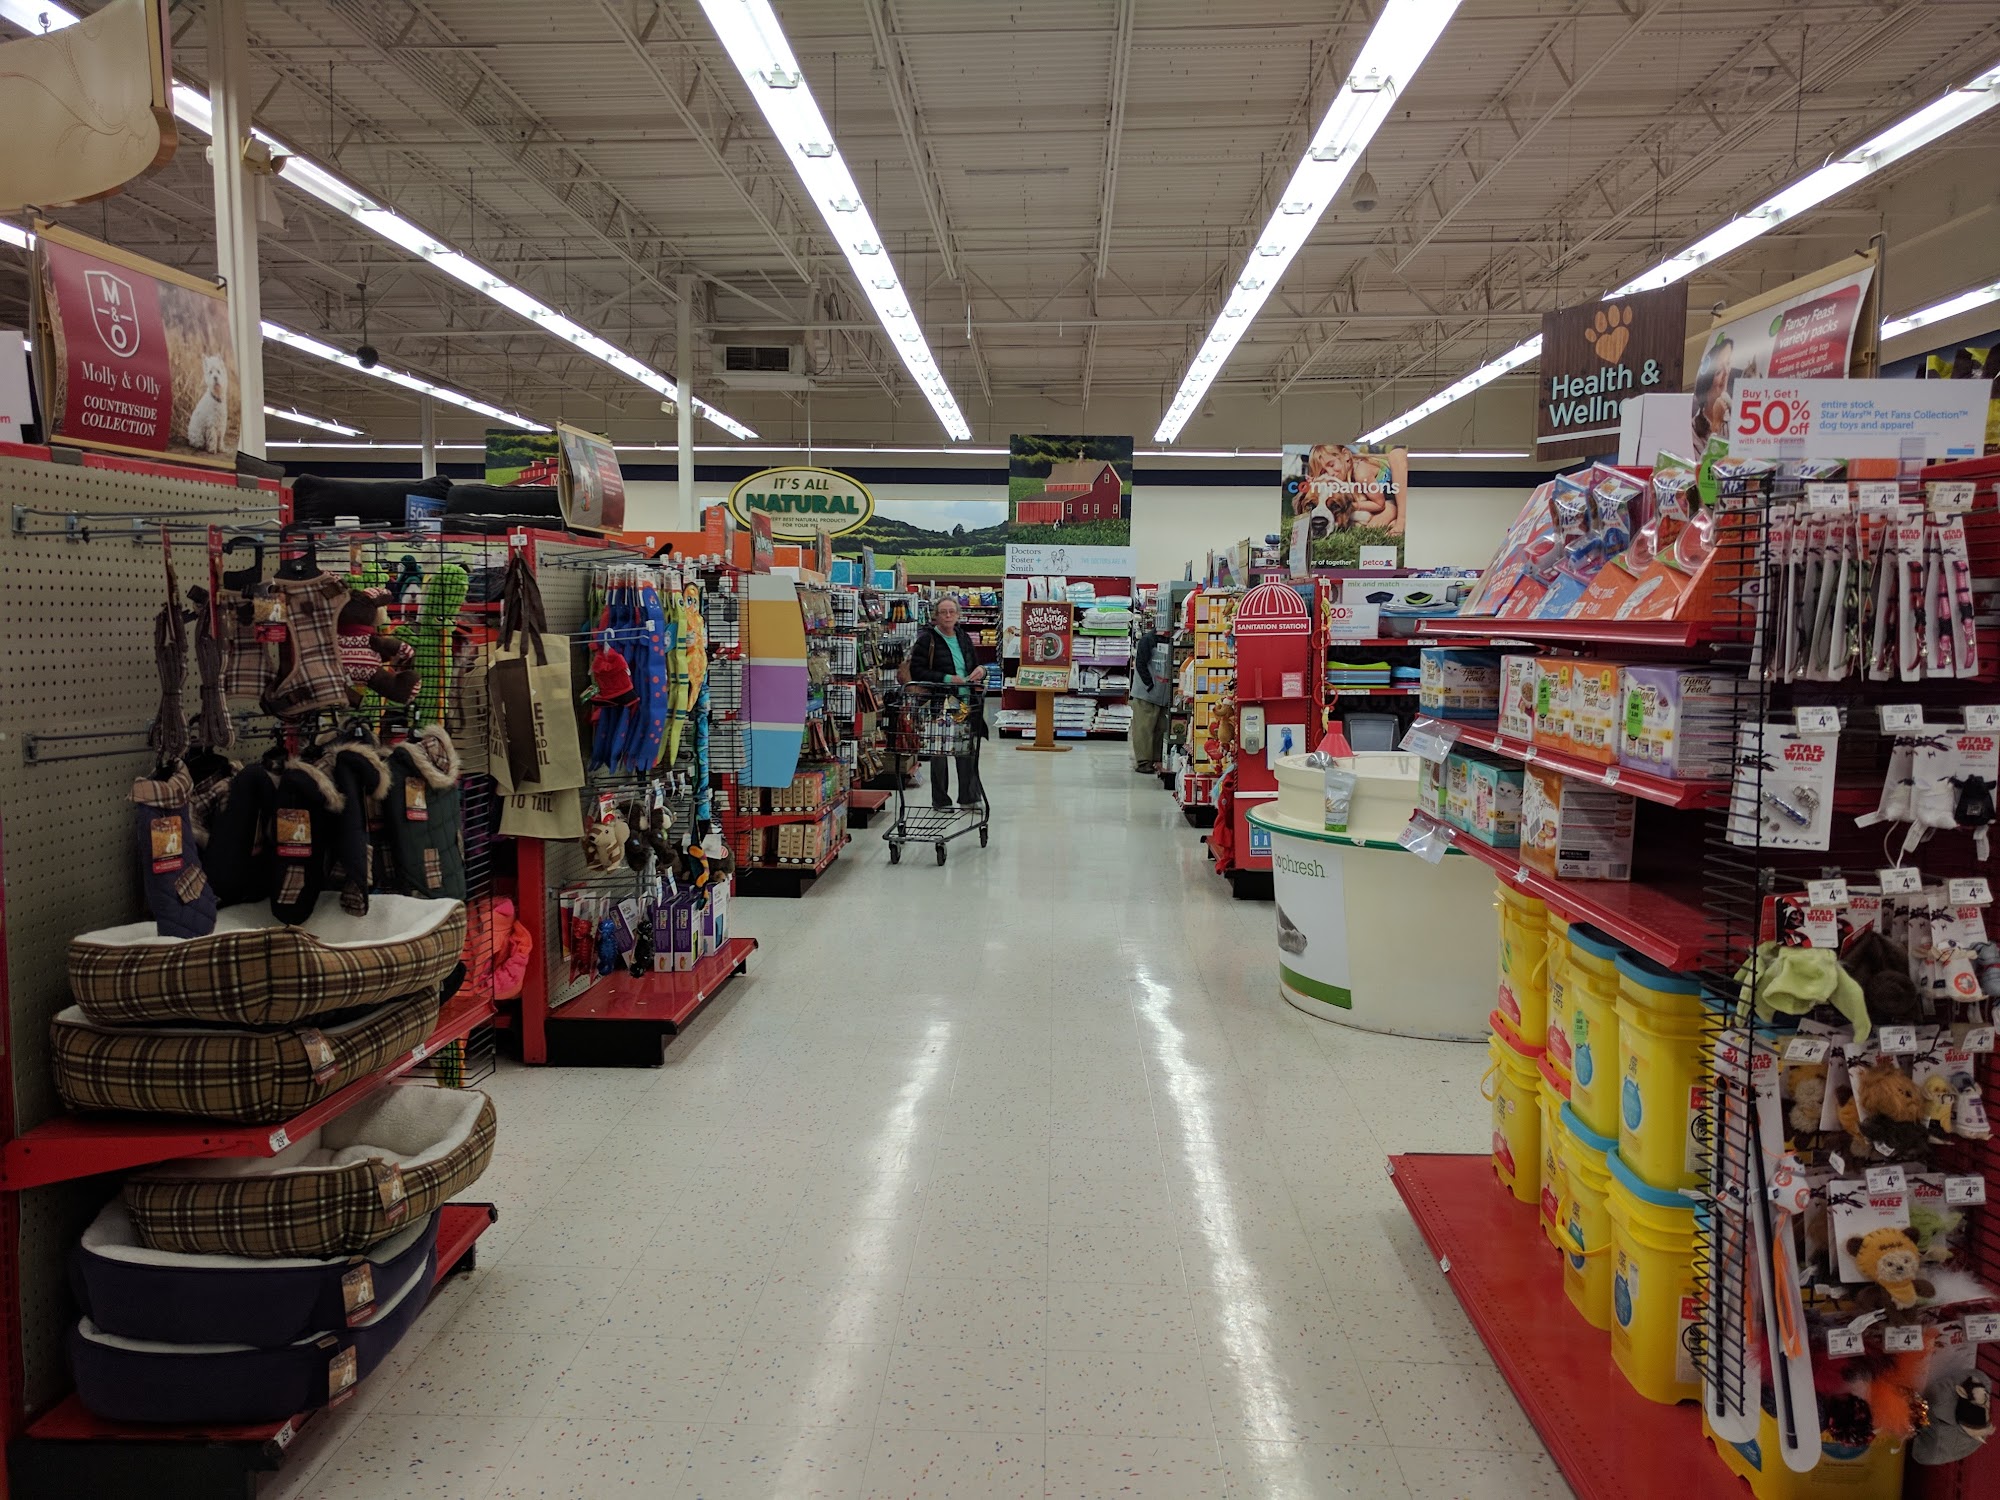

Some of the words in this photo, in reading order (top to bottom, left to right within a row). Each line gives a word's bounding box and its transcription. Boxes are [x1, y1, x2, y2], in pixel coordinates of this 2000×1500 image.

[101, 277, 120, 305] M
[111, 306, 120, 322] &
[1784, 315, 1811, 332] Fancy
[1811, 303, 1837, 322] Feast
[111, 325, 127, 349] O
[1780, 330, 1811, 348] variety
[1809, 320, 1838, 342] packs
[1780, 348, 1808, 363] convenient
[1819, 342, 1829, 352] top
[1778, 364, 1794, 374] makes
[1800, 357, 1815, 368] quick
[1816, 352, 1828, 361] and
[1796, 369, 1809, 378] feed
[1810, 366, 1822, 377] your
[1823, 362, 1834, 373] pet
[81, 361, 118, 391] Molly
[122, 371, 132, 389] &
[136, 374, 161, 400] Olly
[1552, 363, 1633, 400] Health
[1640, 359, 1660, 386] &
[1743, 389, 1761, 400] Buy
[1764, 389, 1771, 400] 1,
[1774, 389, 1792, 399] Get
[1795, 389, 1798, 398] 1
[84, 395, 157, 420] COUNTRYSIDE
[1821, 401, 1847, 409] entire
[1850, 401, 1874, 409] stock
[1549, 396, 1622, 428] Welln
[1737, 400, 1810, 436] 50%
[1820, 411, 1839, 419] Star
[1874, 411, 1888, 419] Pet
[1891, 411, 1911, 419] Fans
[82, 411, 156, 436] COLLECTION
[1789, 422, 1810, 436] off
[1820, 421, 1837, 431] dog
[1839, 421, 1858, 431] toys
[1861, 421, 1878, 430] and
[1881, 421, 1914, 431] apparel
[774, 478, 800, 490] IT'S
[805, 479, 829, 490] ALL
[1288, 479, 1400, 497] companions
[746, 493, 859, 515] NATURAL
[1011, 547, 1041, 555] Doctors
[1011, 555, 1034, 563] Foster
[1363, 559, 1384, 567] petco
[1010, 564, 1033, 572] Smith
[1348, 580, 1360, 588] mix
[1362, 580, 1376, 588] and
[1378, 580, 1400, 588] match
[1032, 608, 1044, 616] fill
[1026, 613, 1068, 626] stockings
[1462, 668, 1486, 676] Fancy
[1683, 677, 1712, 686] Fancy
[1686, 685, 1712, 694] Feast
[1790, 743, 1825, 753] STAR
[1957, 742, 1994, 751] WARS
[1784, 751, 1825, 762] WARS
[532, 795, 553, 812] TAIL
[1275, 853, 1325, 878] sophresh
[1807, 914, 1835, 922] WARS
[1869, 1196, 1903, 1208] WARS
